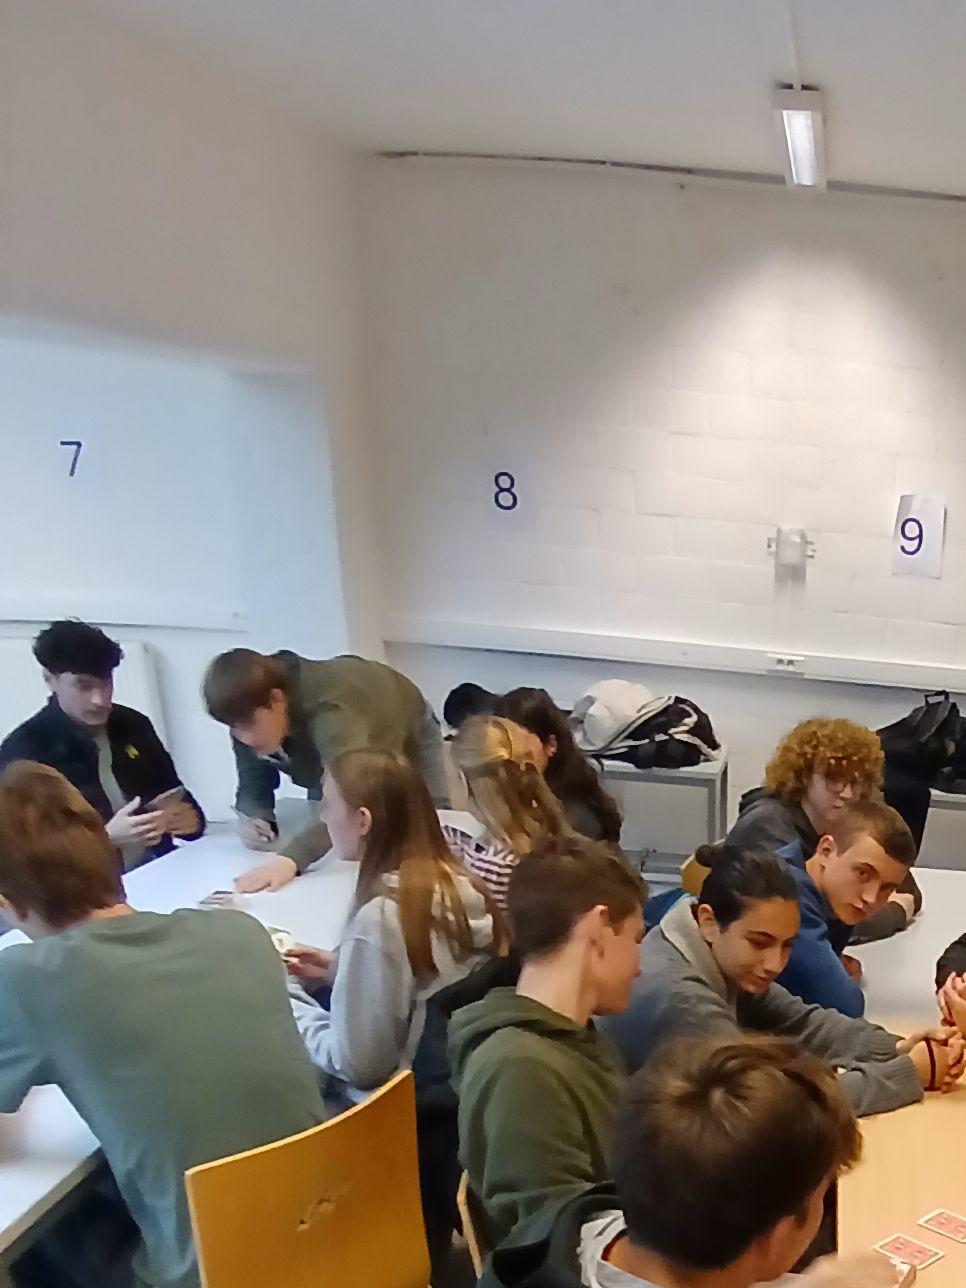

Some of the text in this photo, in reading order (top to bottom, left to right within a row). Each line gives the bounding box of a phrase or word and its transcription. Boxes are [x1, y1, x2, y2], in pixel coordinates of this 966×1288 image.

[60, 441, 82, 478] 7
[494, 472, 518, 511] 8
[899, 518, 924, 556] 9
